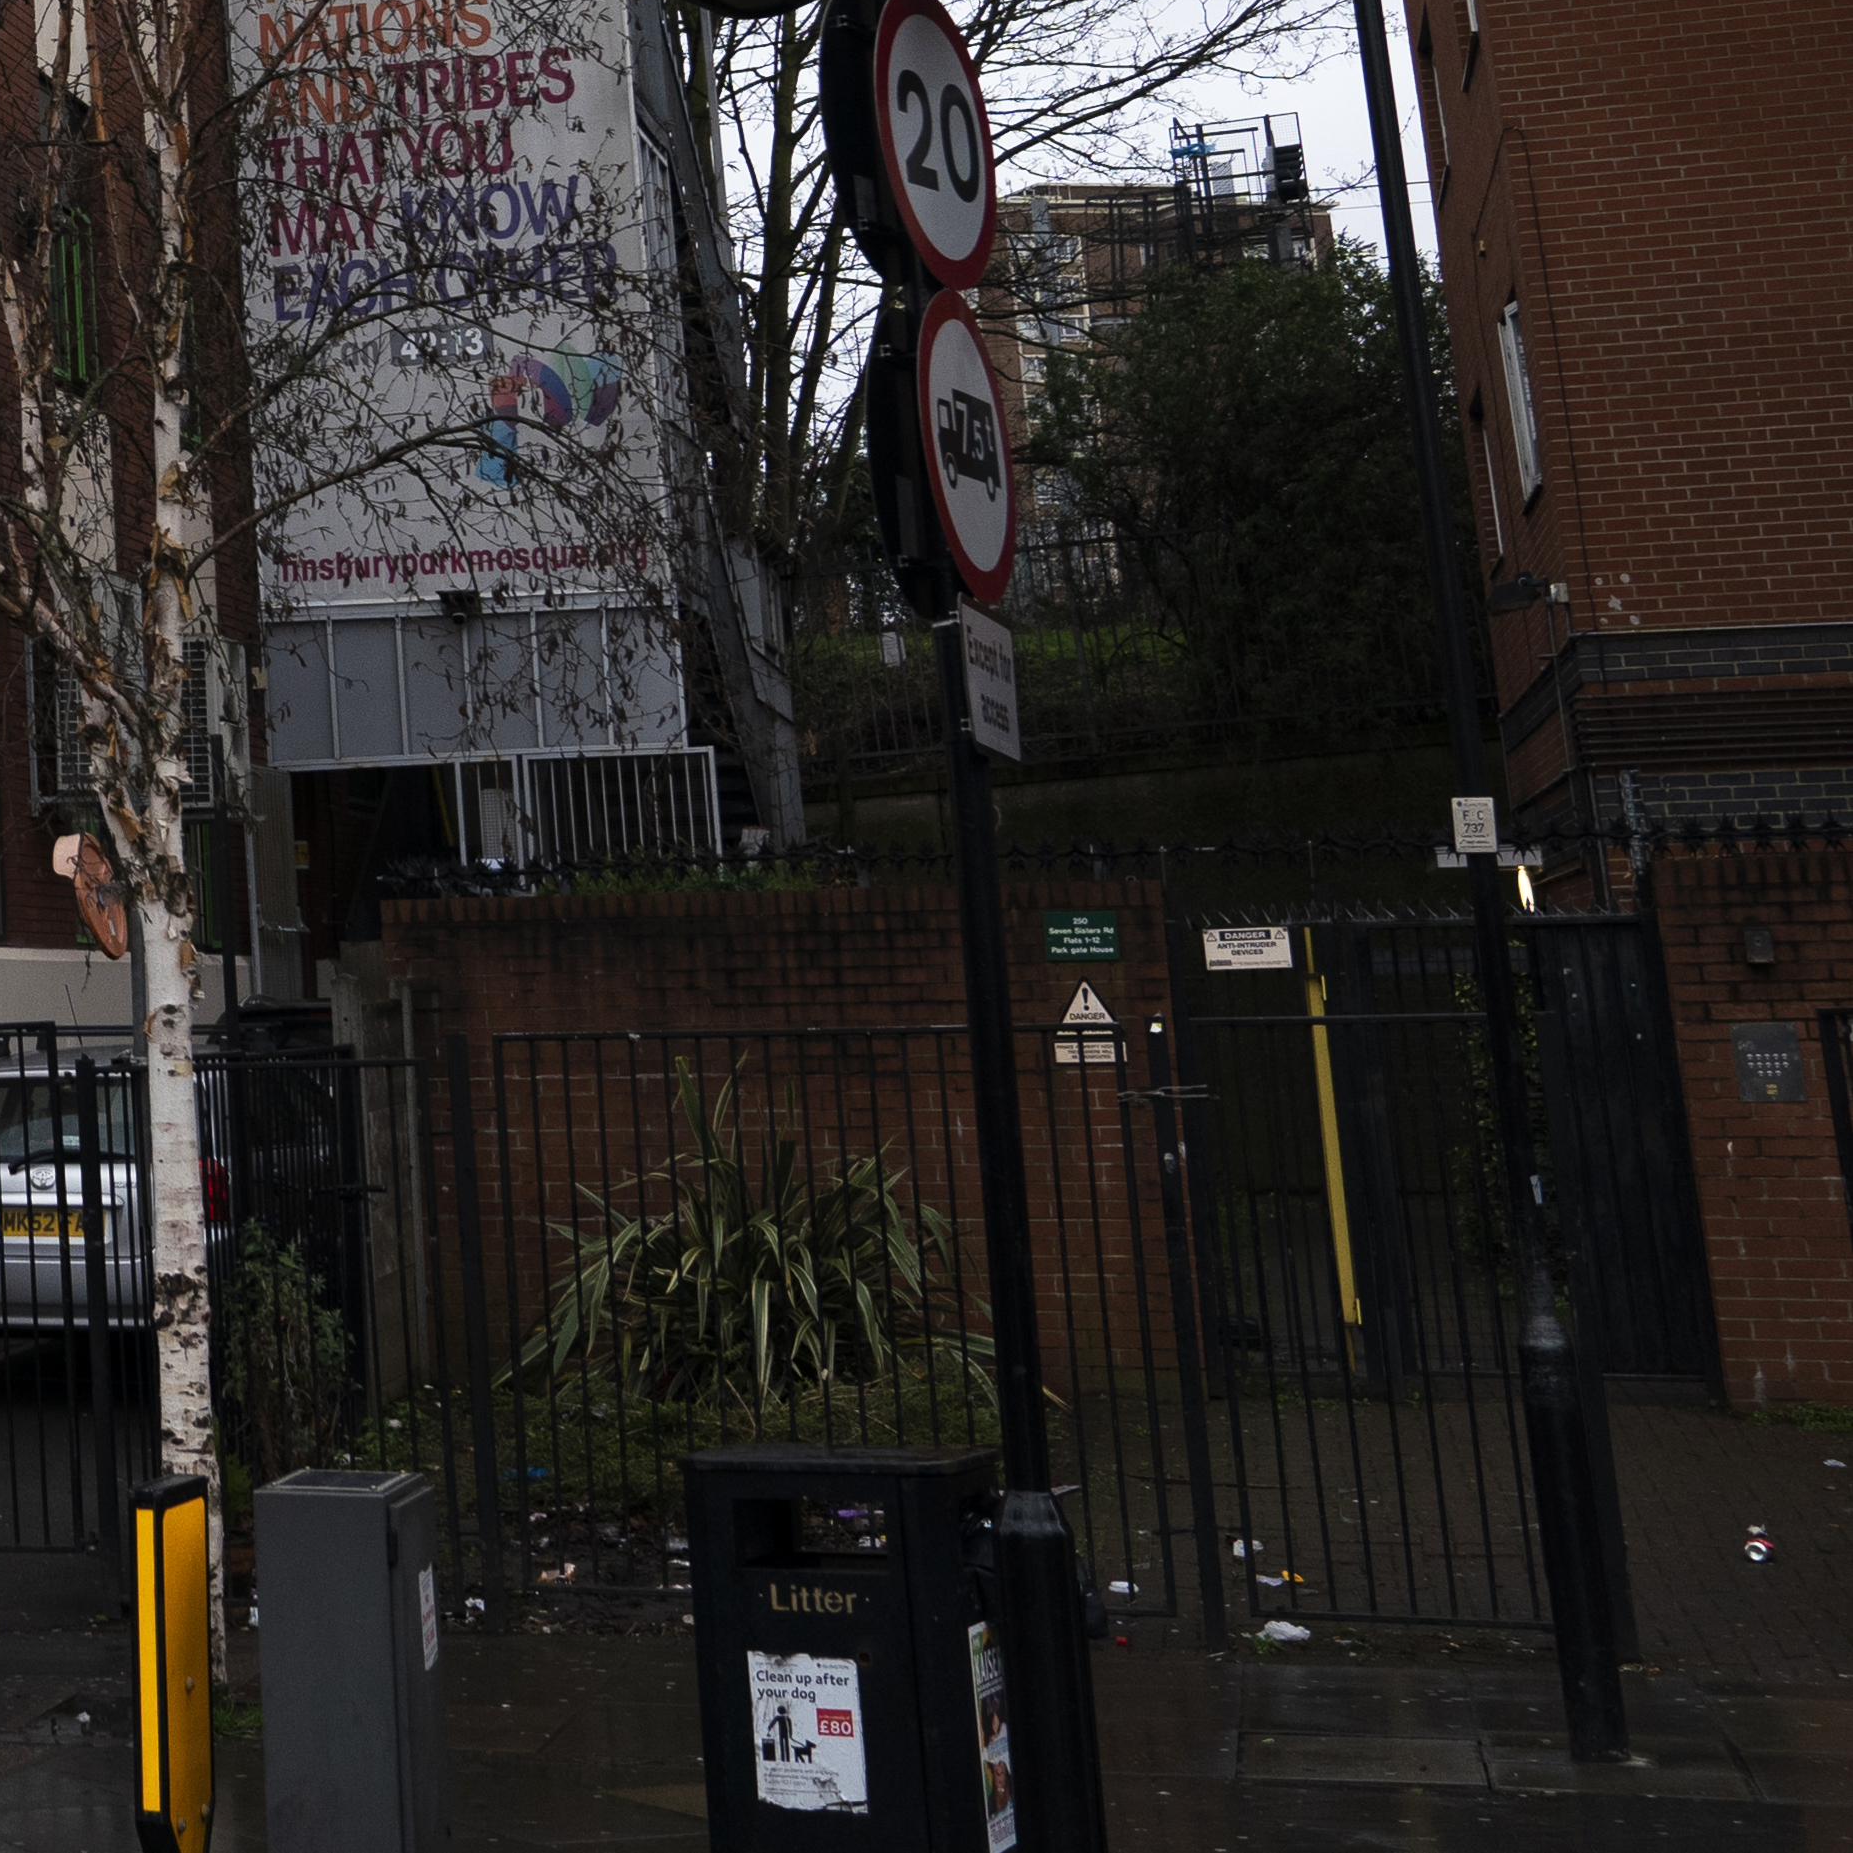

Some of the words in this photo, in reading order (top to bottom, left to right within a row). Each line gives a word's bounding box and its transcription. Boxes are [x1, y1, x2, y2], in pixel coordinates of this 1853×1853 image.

[263, 68, 377, 127] AND
[384, 47, 576, 117] TRIBES
[897, 69, 980, 204] 20
[265, 129, 389, 193] THAT
[390, 118, 513, 179] YOU
[270, 192, 384, 257] MAY
[400, 174, 579, 245] KNOW
[273, 256, 419, 322] EACH
[434, 240, 618, 309] OTHER
[967, 625, 999, 682] Except
[999, 642, 1012, 685] for
[981, 694, 1010, 734] access
[1463, 823, 1485, 833] 737
[1072, 917, 1088, 925] 250
[1048, 927, 1072, 935] Seven
[1074, 926, 1101, 935] Sisters
[1103, 926, 1114, 934] Rd
[1224, 931, 1266, 940] DANGER
[1051, 946, 1068, 954] Park
[1070, 946, 1088, 955] gate
[1090, 945, 1114, 953] House
[1217, 941, 1277, 950] ANTI-INTRUDER
[1231, 948, 1264, 956] DEVICES
[1069, 1012, 1106, 1021] DANGER
[769, 1583, 857, 1614] Litter
[756, 1670, 793, 1683] Clean
[795, 1674, 812, 1686] up
[815, 1672, 850, 1686] after
[757, 1688, 788, 1701] your
[791, 1686, 817, 1703] dog
[819, 1720, 852, 1736] £80
